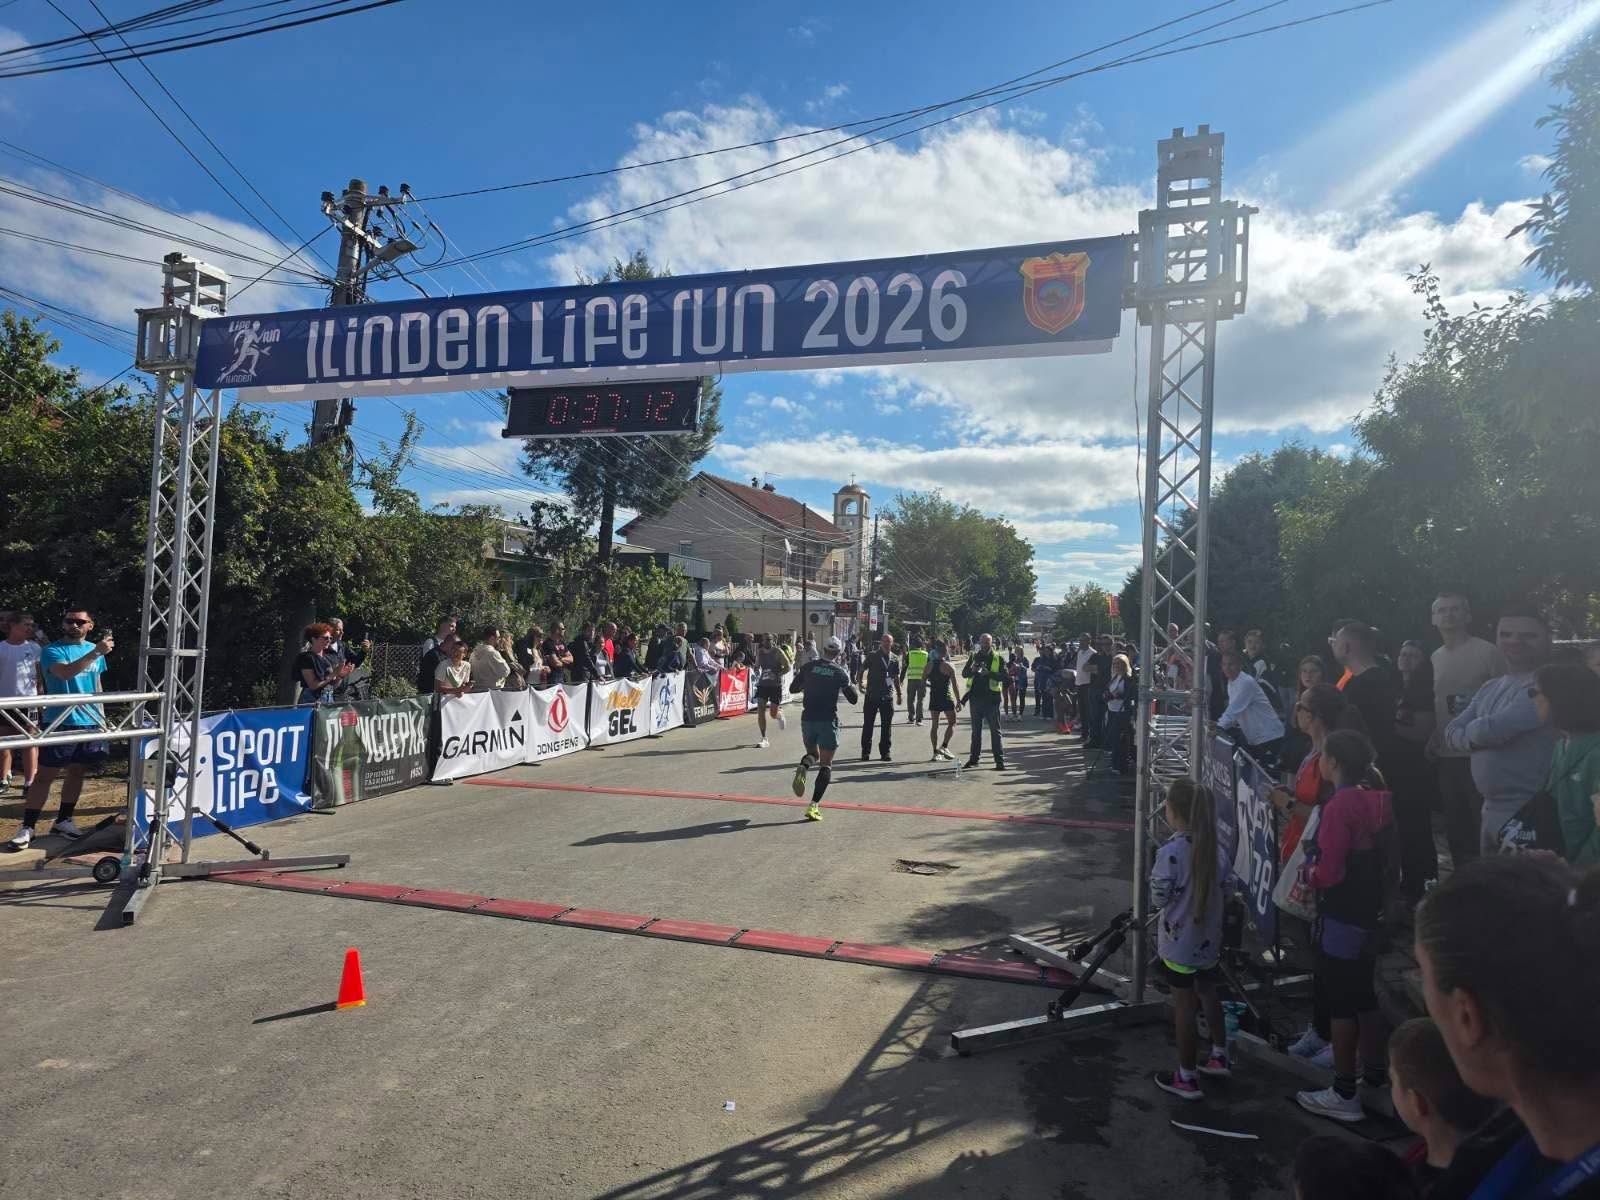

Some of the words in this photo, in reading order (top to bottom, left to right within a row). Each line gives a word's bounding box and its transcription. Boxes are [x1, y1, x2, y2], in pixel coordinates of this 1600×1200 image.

[801, 269, 968, 349] 2026
[549, 391, 675, 425] 0:37:12
[325, 710, 425, 769] ПИСТЕРКА
[608, 709, 637, 737] GEL
[442, 725, 525, 760] GARMIN
[537, 736, 579, 756] DONGFENG
